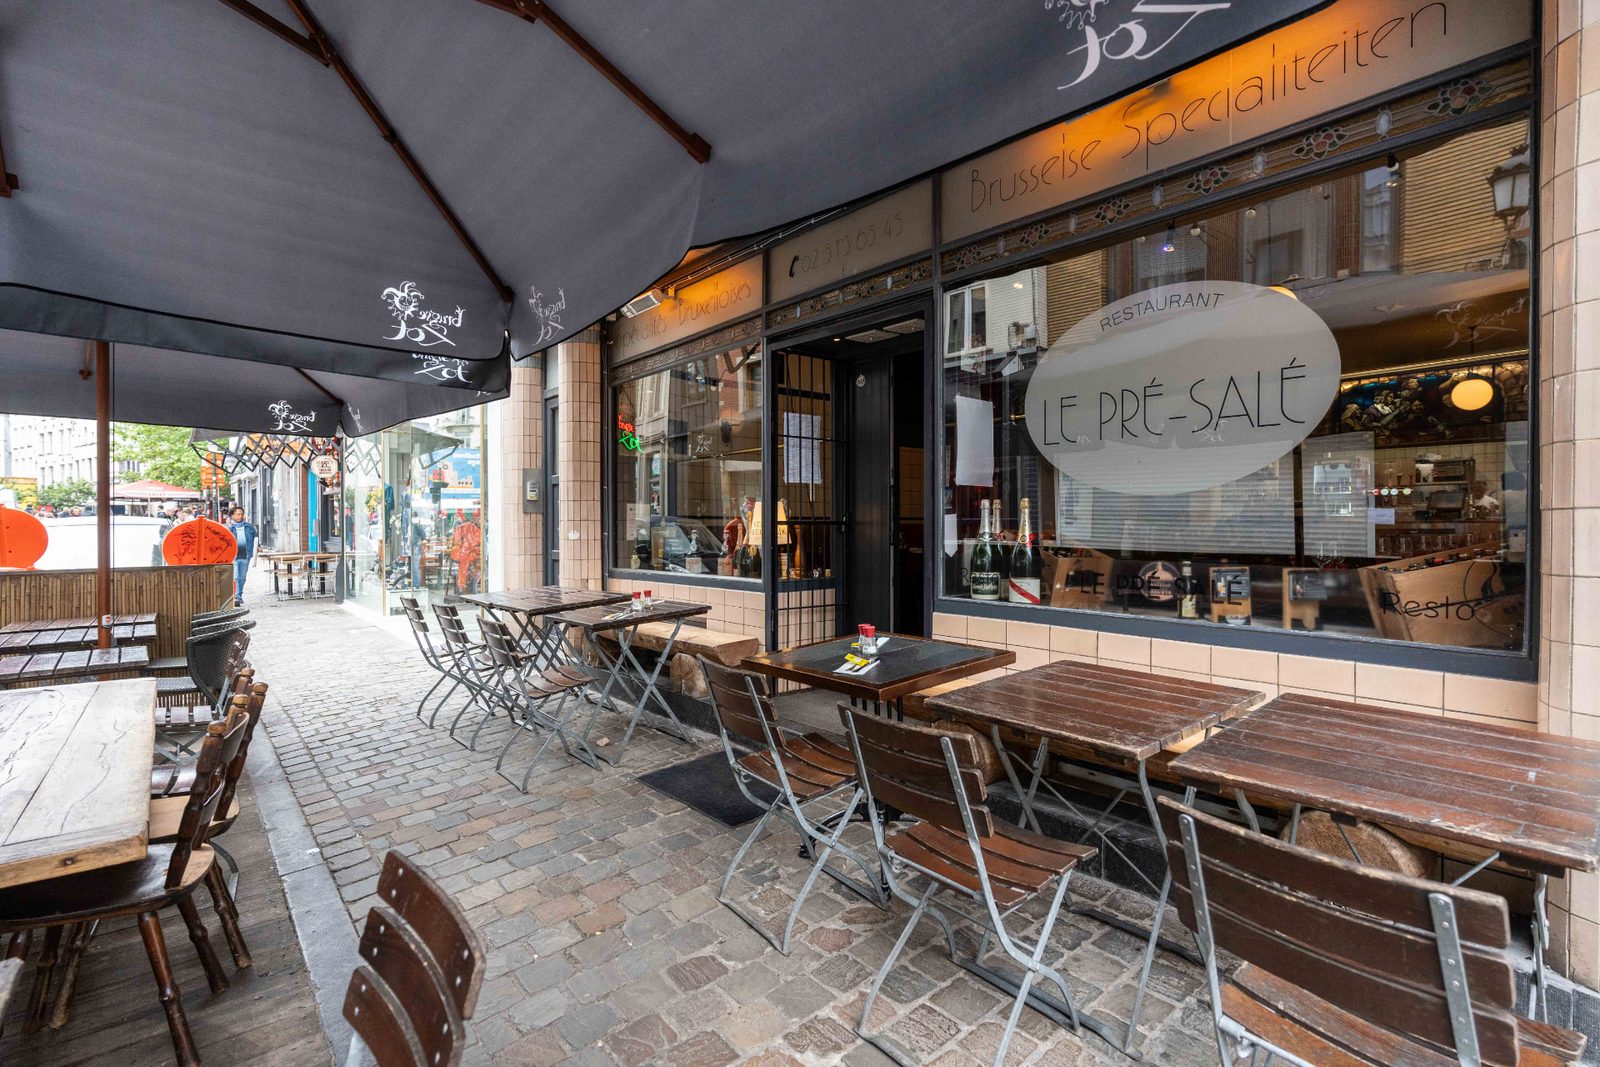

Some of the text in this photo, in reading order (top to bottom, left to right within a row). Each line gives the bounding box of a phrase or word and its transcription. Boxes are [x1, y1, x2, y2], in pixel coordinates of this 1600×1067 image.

[971, 2, 1447, 213] Brusselse Specialiteiten
[1100, 292, 1224, 332] RESTAURANT
[1043, 357, 1306, 446] LE PRÉ-SALÉ
[1382, 592, 1475, 621] Resto
